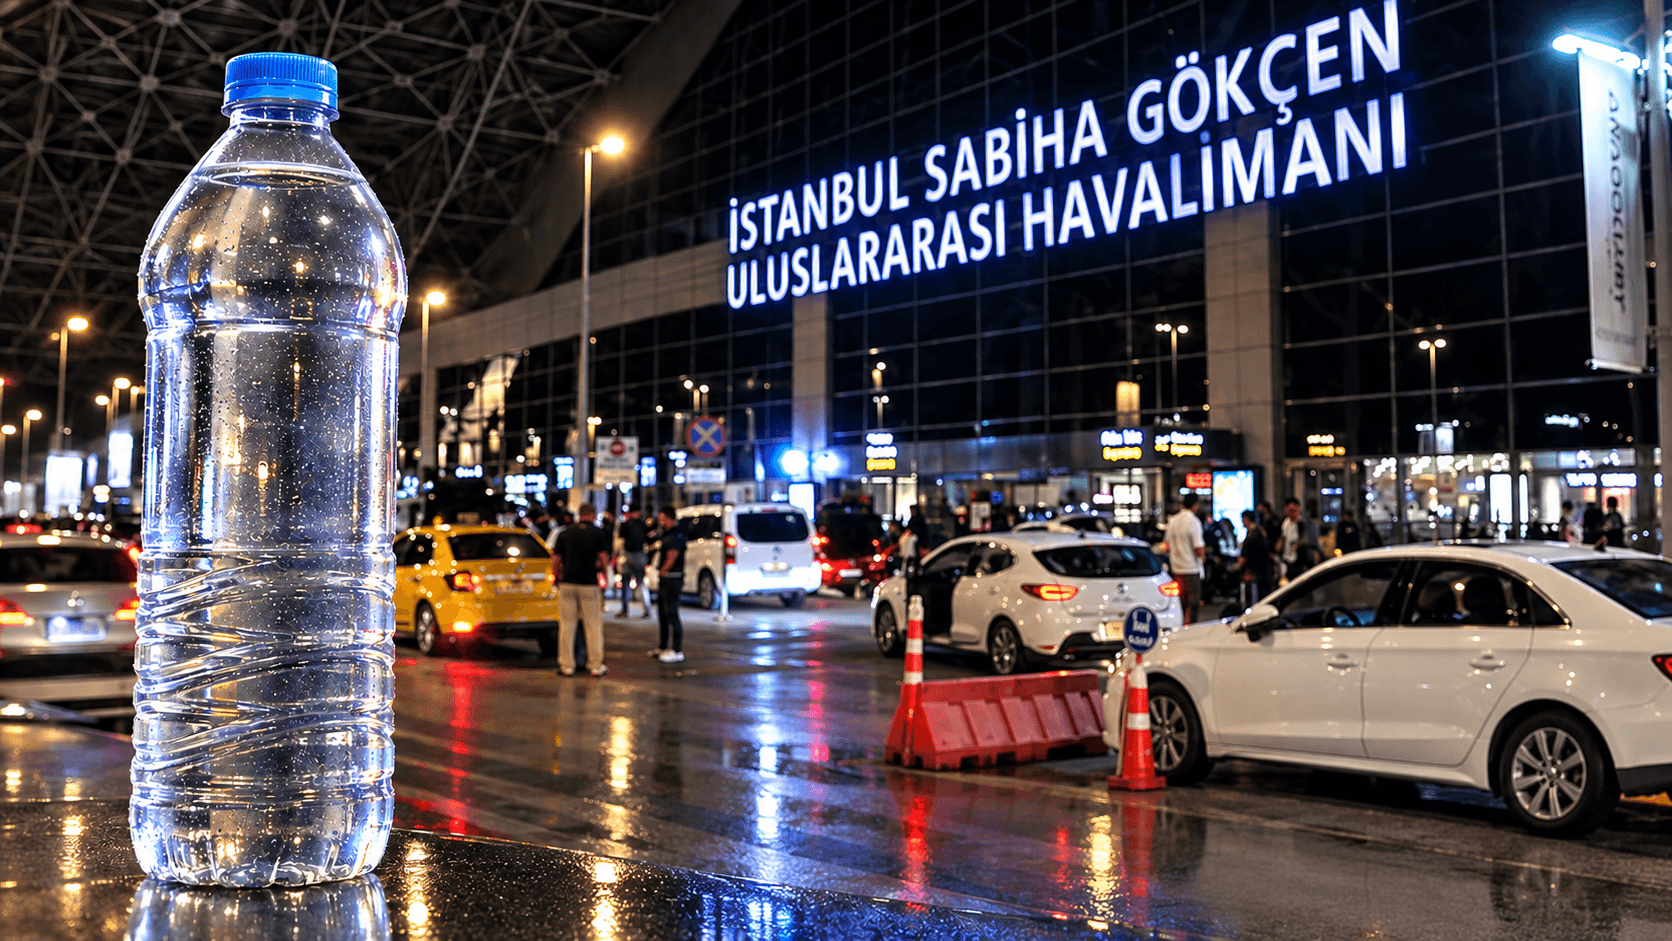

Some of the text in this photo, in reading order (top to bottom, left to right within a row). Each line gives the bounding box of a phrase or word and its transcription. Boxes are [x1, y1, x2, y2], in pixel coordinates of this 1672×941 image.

[727, 92, 1407, 309] ULUSLARARASI HAVALİMANI
[729, 0, 1401, 254] İSTANBUL SABİHA GÖKÇEN
